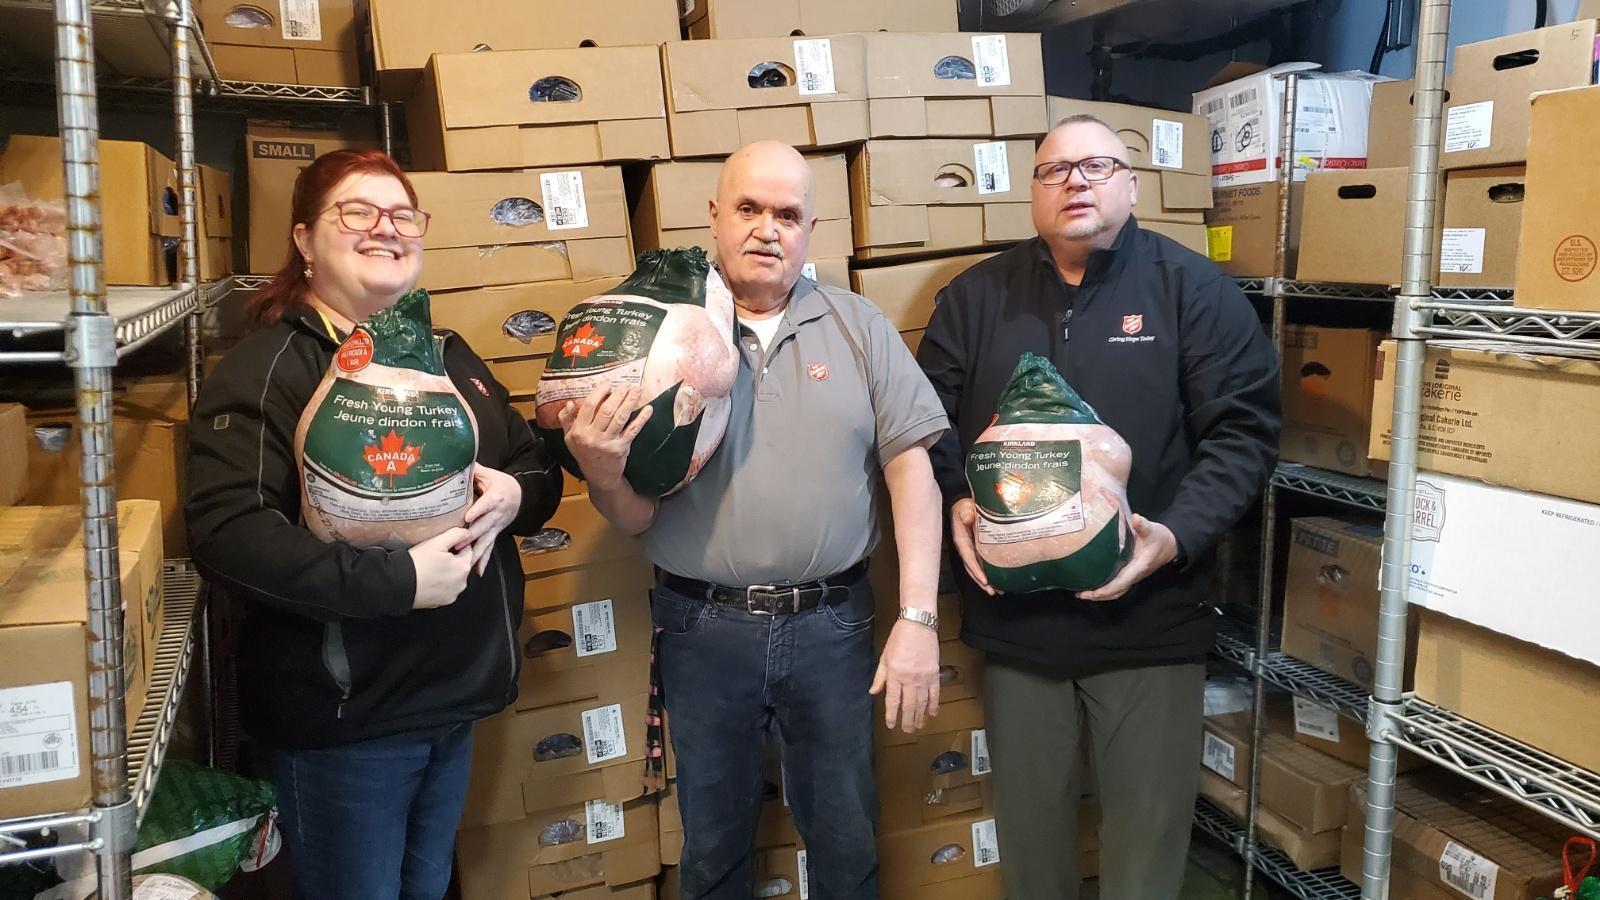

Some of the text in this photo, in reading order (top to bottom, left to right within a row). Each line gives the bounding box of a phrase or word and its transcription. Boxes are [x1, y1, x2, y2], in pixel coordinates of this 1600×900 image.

[258, 143, 310, 158] SMALL
[585, 307, 613, 315] Young
[616, 308, 654, 320] Turkey
[582, 314, 617, 324] dindon
[619, 316, 648, 328] frais
[563, 337, 600, 348] CANADA
[571, 344, 581, 354] A
[1422, 383, 1462, 402] akerie
[1434, 382, 1462, 392] ORIGINAL
[333, 394, 458, 416] Fresh Young Turkey
[333, 410, 463, 429] Jeune dindon frais
[1436, 415, 1460, 426] Cakerie
[1461, 418, 1473, 428] Ltd.
[367, 451, 415, 463] CANADA
[970, 451, 1070, 461] Fresh Young Turkey
[386, 462, 397, 472] A
[976, 459, 1069, 472] Jeune dindon frais
[1415, 497, 1431, 512] OCK
[1555, 512, 1595, 526] REFRIGERATED
